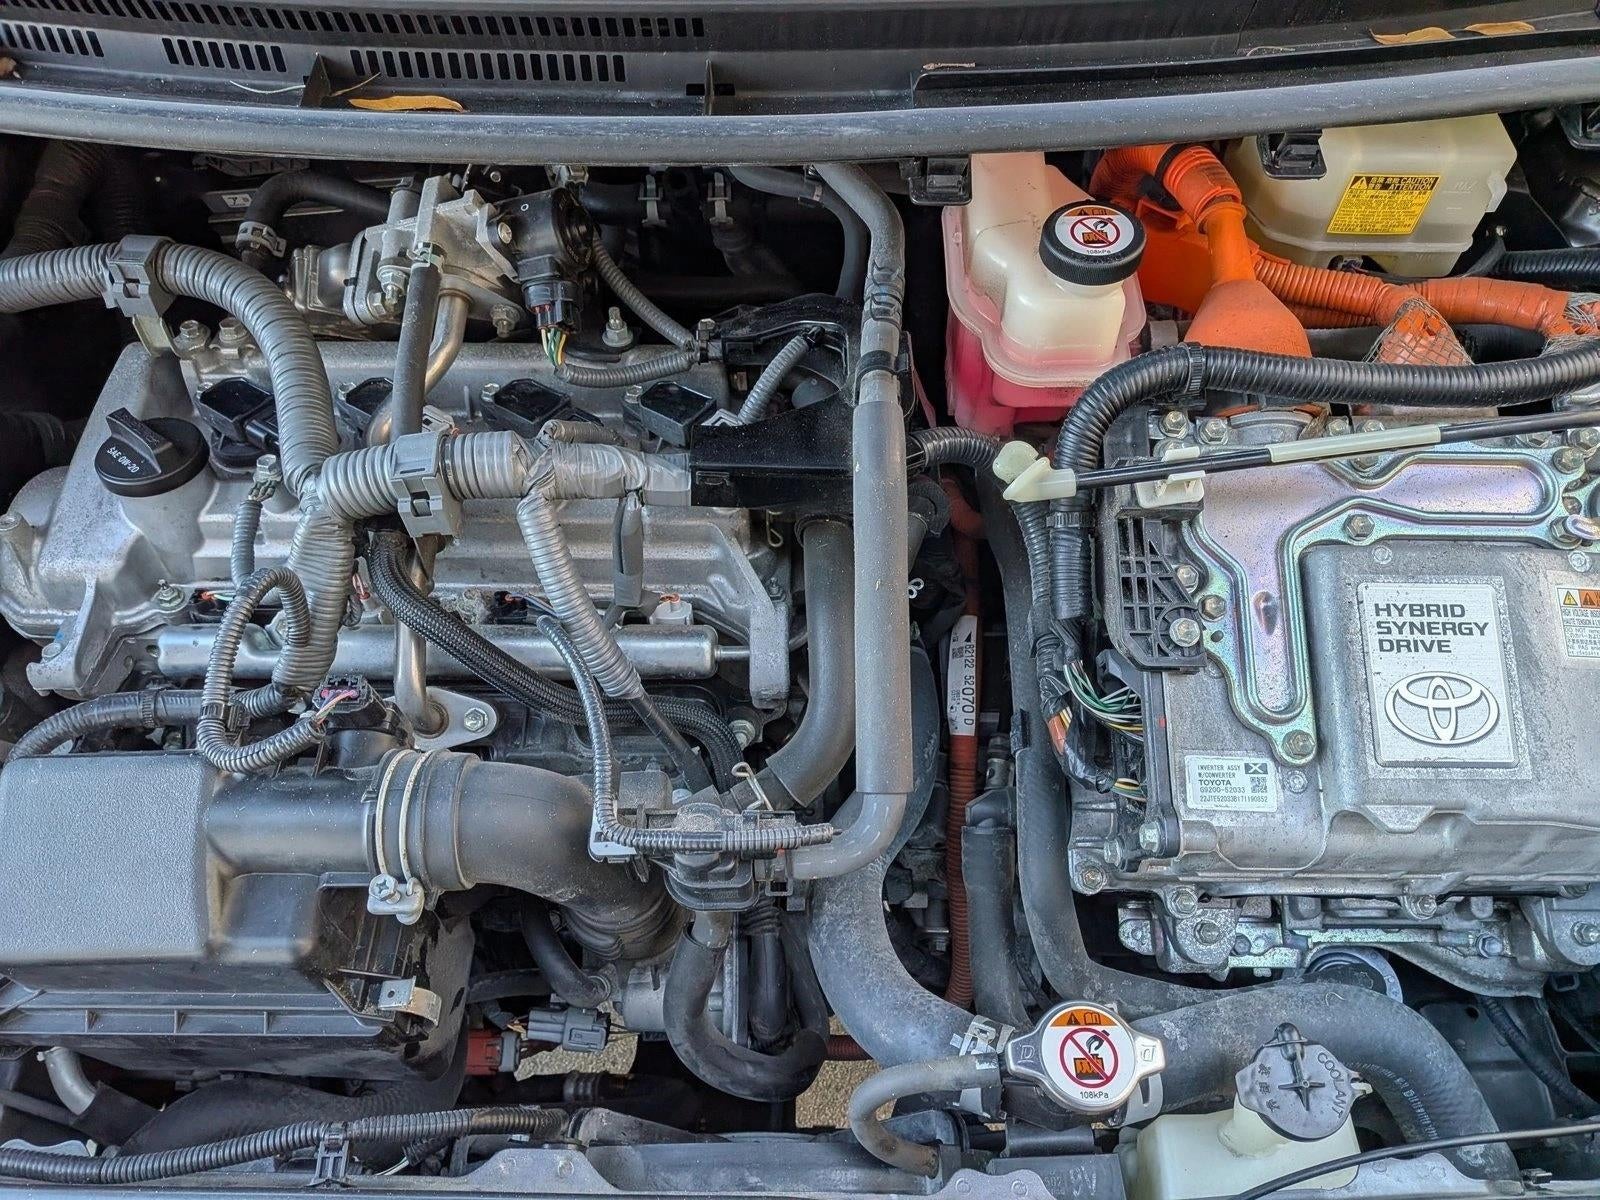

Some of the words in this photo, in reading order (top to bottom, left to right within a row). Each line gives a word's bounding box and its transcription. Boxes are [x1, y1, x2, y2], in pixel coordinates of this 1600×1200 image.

[106, 446, 121, 459] SAE
[118, 455, 140, 473] 0W-20
[1374, 603, 1466, 618] HYBRID
[1376, 621, 1490, 636] SYNERGY
[1378, 639, 1452, 653] DRIVE
[961, 675, 975, 714] 52070
[964, 718, 975, 726] D
[1200, 786, 1246, 794] G9200-52033
[1317, 1051, 1347, 1119] COOLANT
[1079, 1091, 1109, 1099] 108kPa
